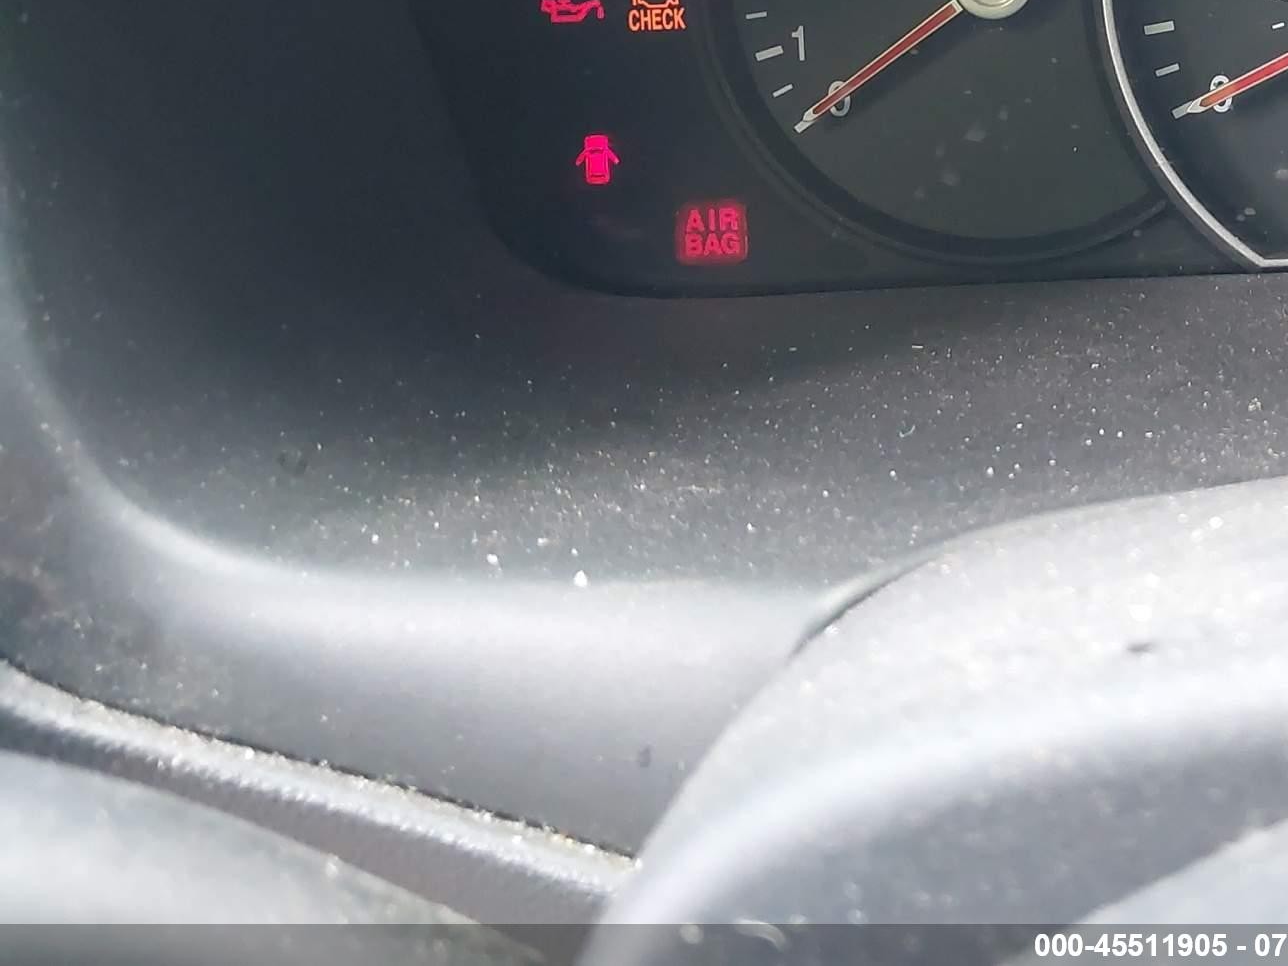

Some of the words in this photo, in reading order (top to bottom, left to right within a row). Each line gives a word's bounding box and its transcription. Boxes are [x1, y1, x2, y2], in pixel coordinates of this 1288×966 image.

[628, 8, 686, 32] CHECK
[792, 26, 805, 61] 1
[686, 208, 739, 232] AIR
[685, 233, 740, 256] BAG
